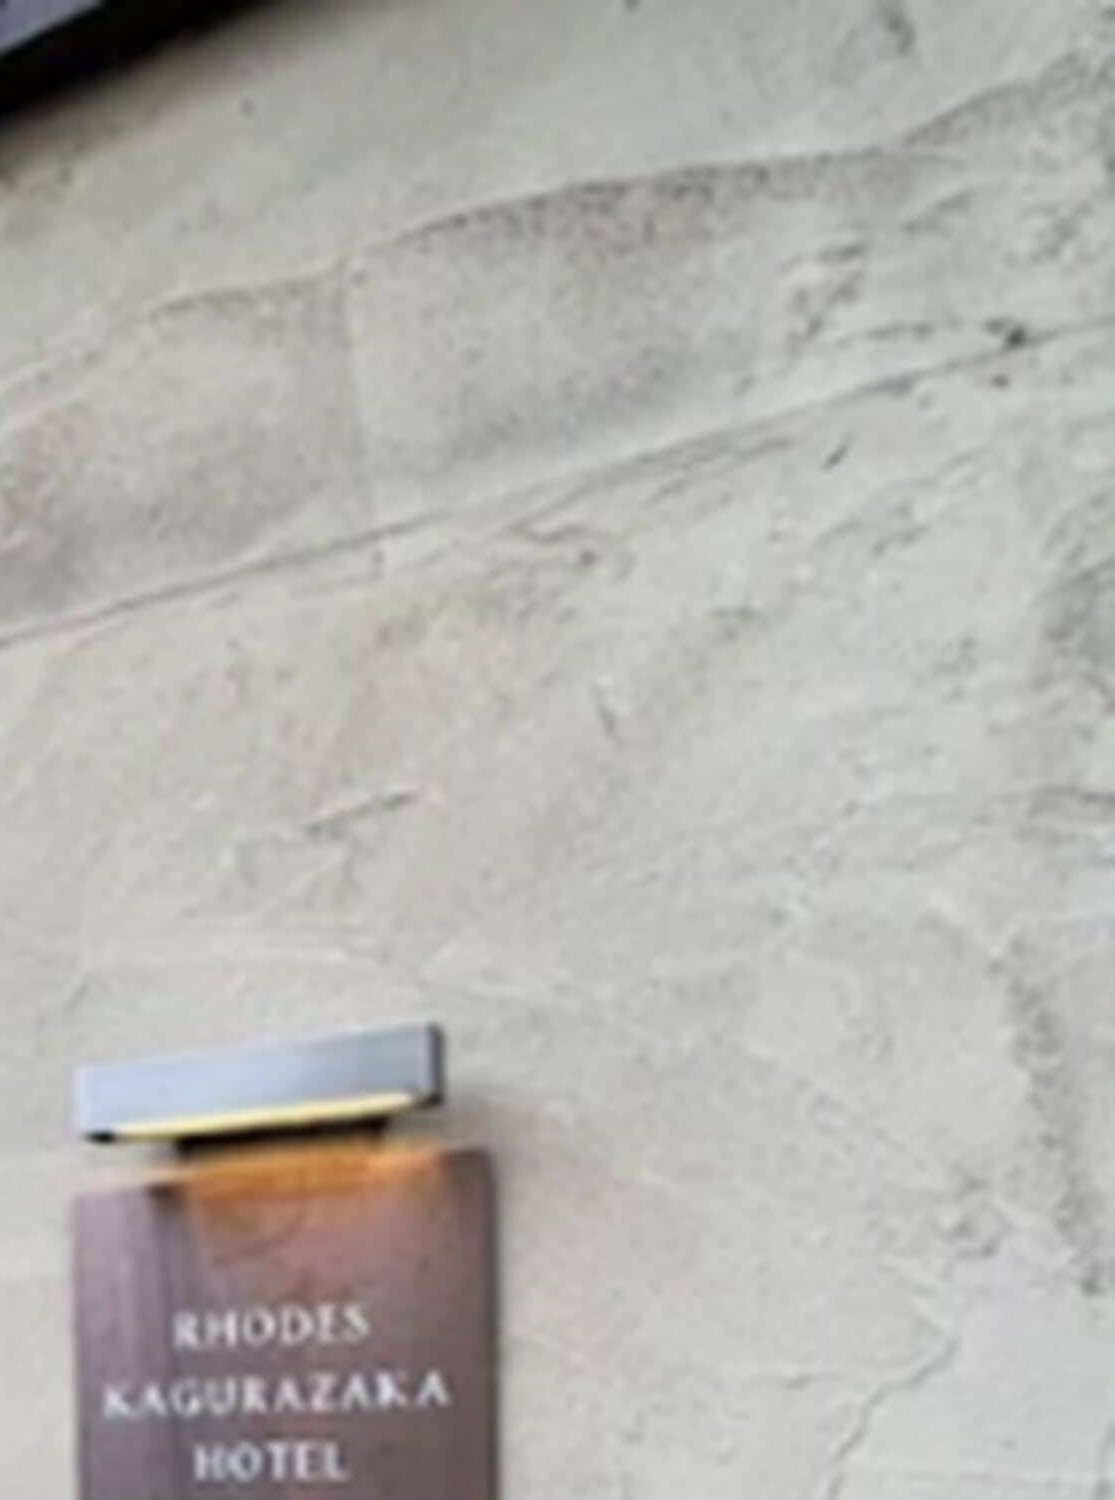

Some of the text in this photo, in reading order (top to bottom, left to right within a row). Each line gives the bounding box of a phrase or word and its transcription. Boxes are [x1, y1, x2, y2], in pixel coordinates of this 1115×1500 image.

[173, 1303, 369, 1351] RHODES
[103, 1369, 450, 1420] KAGURAZAKA
[194, 1441, 349, 1482] HOTEL
